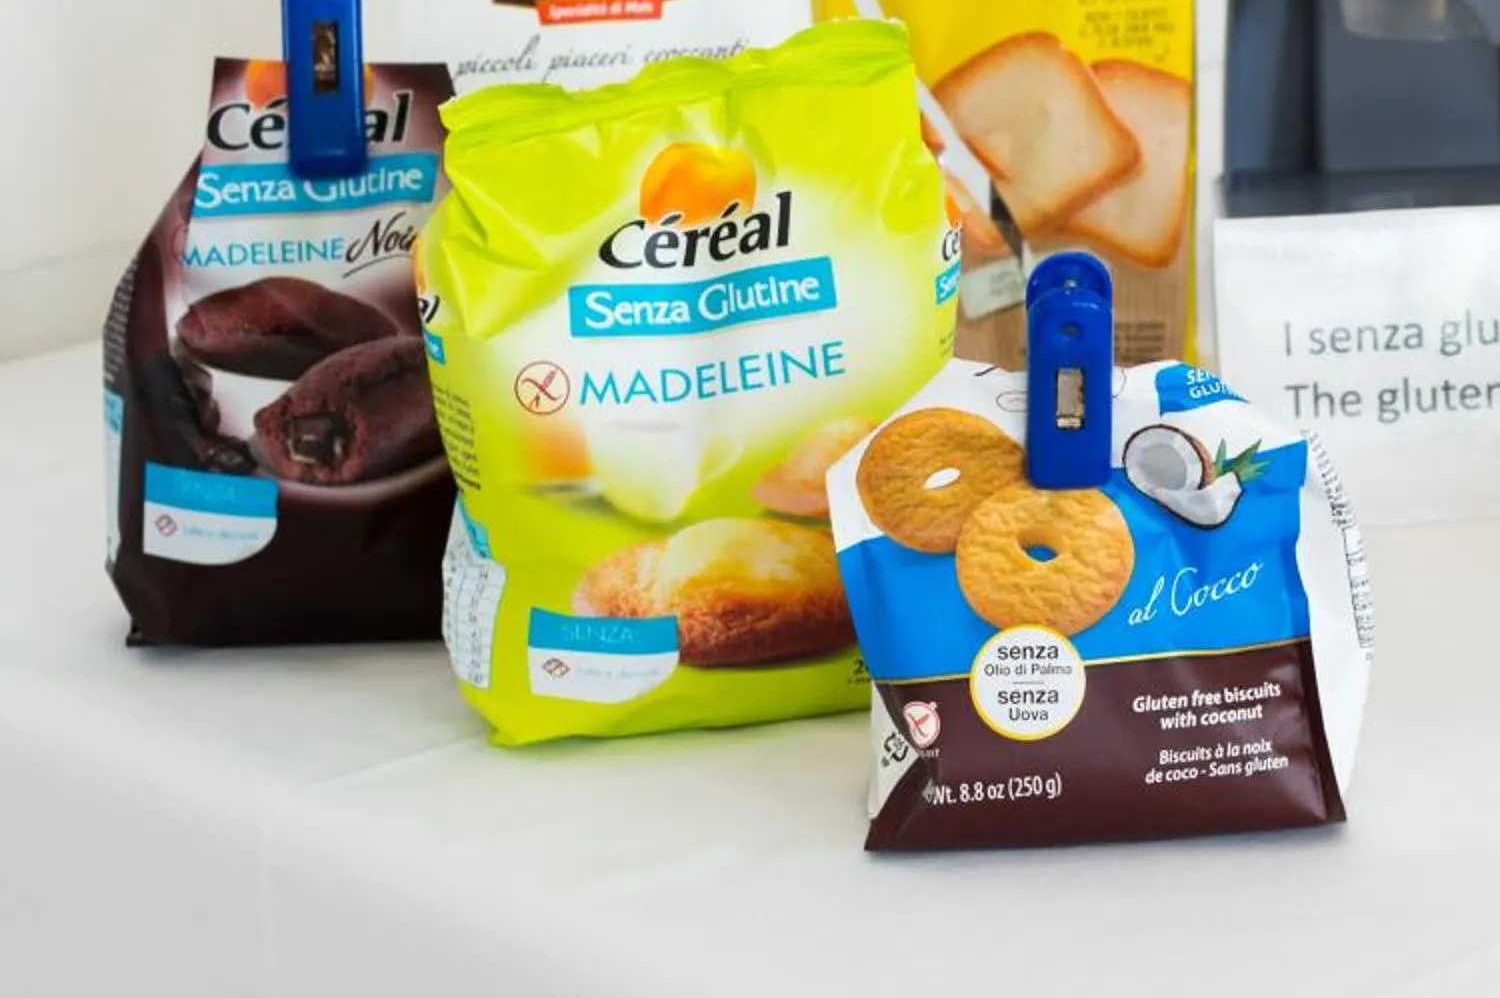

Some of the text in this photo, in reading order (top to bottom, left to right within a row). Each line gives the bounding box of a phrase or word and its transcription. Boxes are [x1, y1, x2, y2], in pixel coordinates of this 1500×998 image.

[454, 34, 541, 79] piccoli
[207, 91, 411, 151] Céal
[195, 172, 296, 208] Senza
[598, 191, 792, 269] Céréal
[182, 238, 345, 268] MADELEINE
[584, 273, 820, 329] Senza Glutine
[1284, 322, 1293, 356] I
[1308, 323, 1424, 356] senza
[579, 341, 846, 404] MADELEINE
[1285, 381, 1362, 419] The
[1127, 561, 1264, 626] al Cocco
[997, 645, 1059, 660] senza
[984, 663, 1073, 677] Olio di Palma
[997, 688, 1059, 704] senza
[1133, 682, 1281, 713] Gluten free biscuits
[1009, 708, 1049, 721] Uova
[1160, 705, 1263, 730] with coconut
[1159, 738, 1273, 765] Biscuits à la noix
[1145, 766, 1163, 785] de
[1165, 765, 1198, 782] coco
[1209, 759, 1242, 777] Sans
[1245, 755, 1289, 776] gluten
[959, 781, 985, 803] 8.8
[987, 783, 1005, 799] oz
[1008, 775, 1042, 800] (250
[1045, 772, 1062, 799] g)
